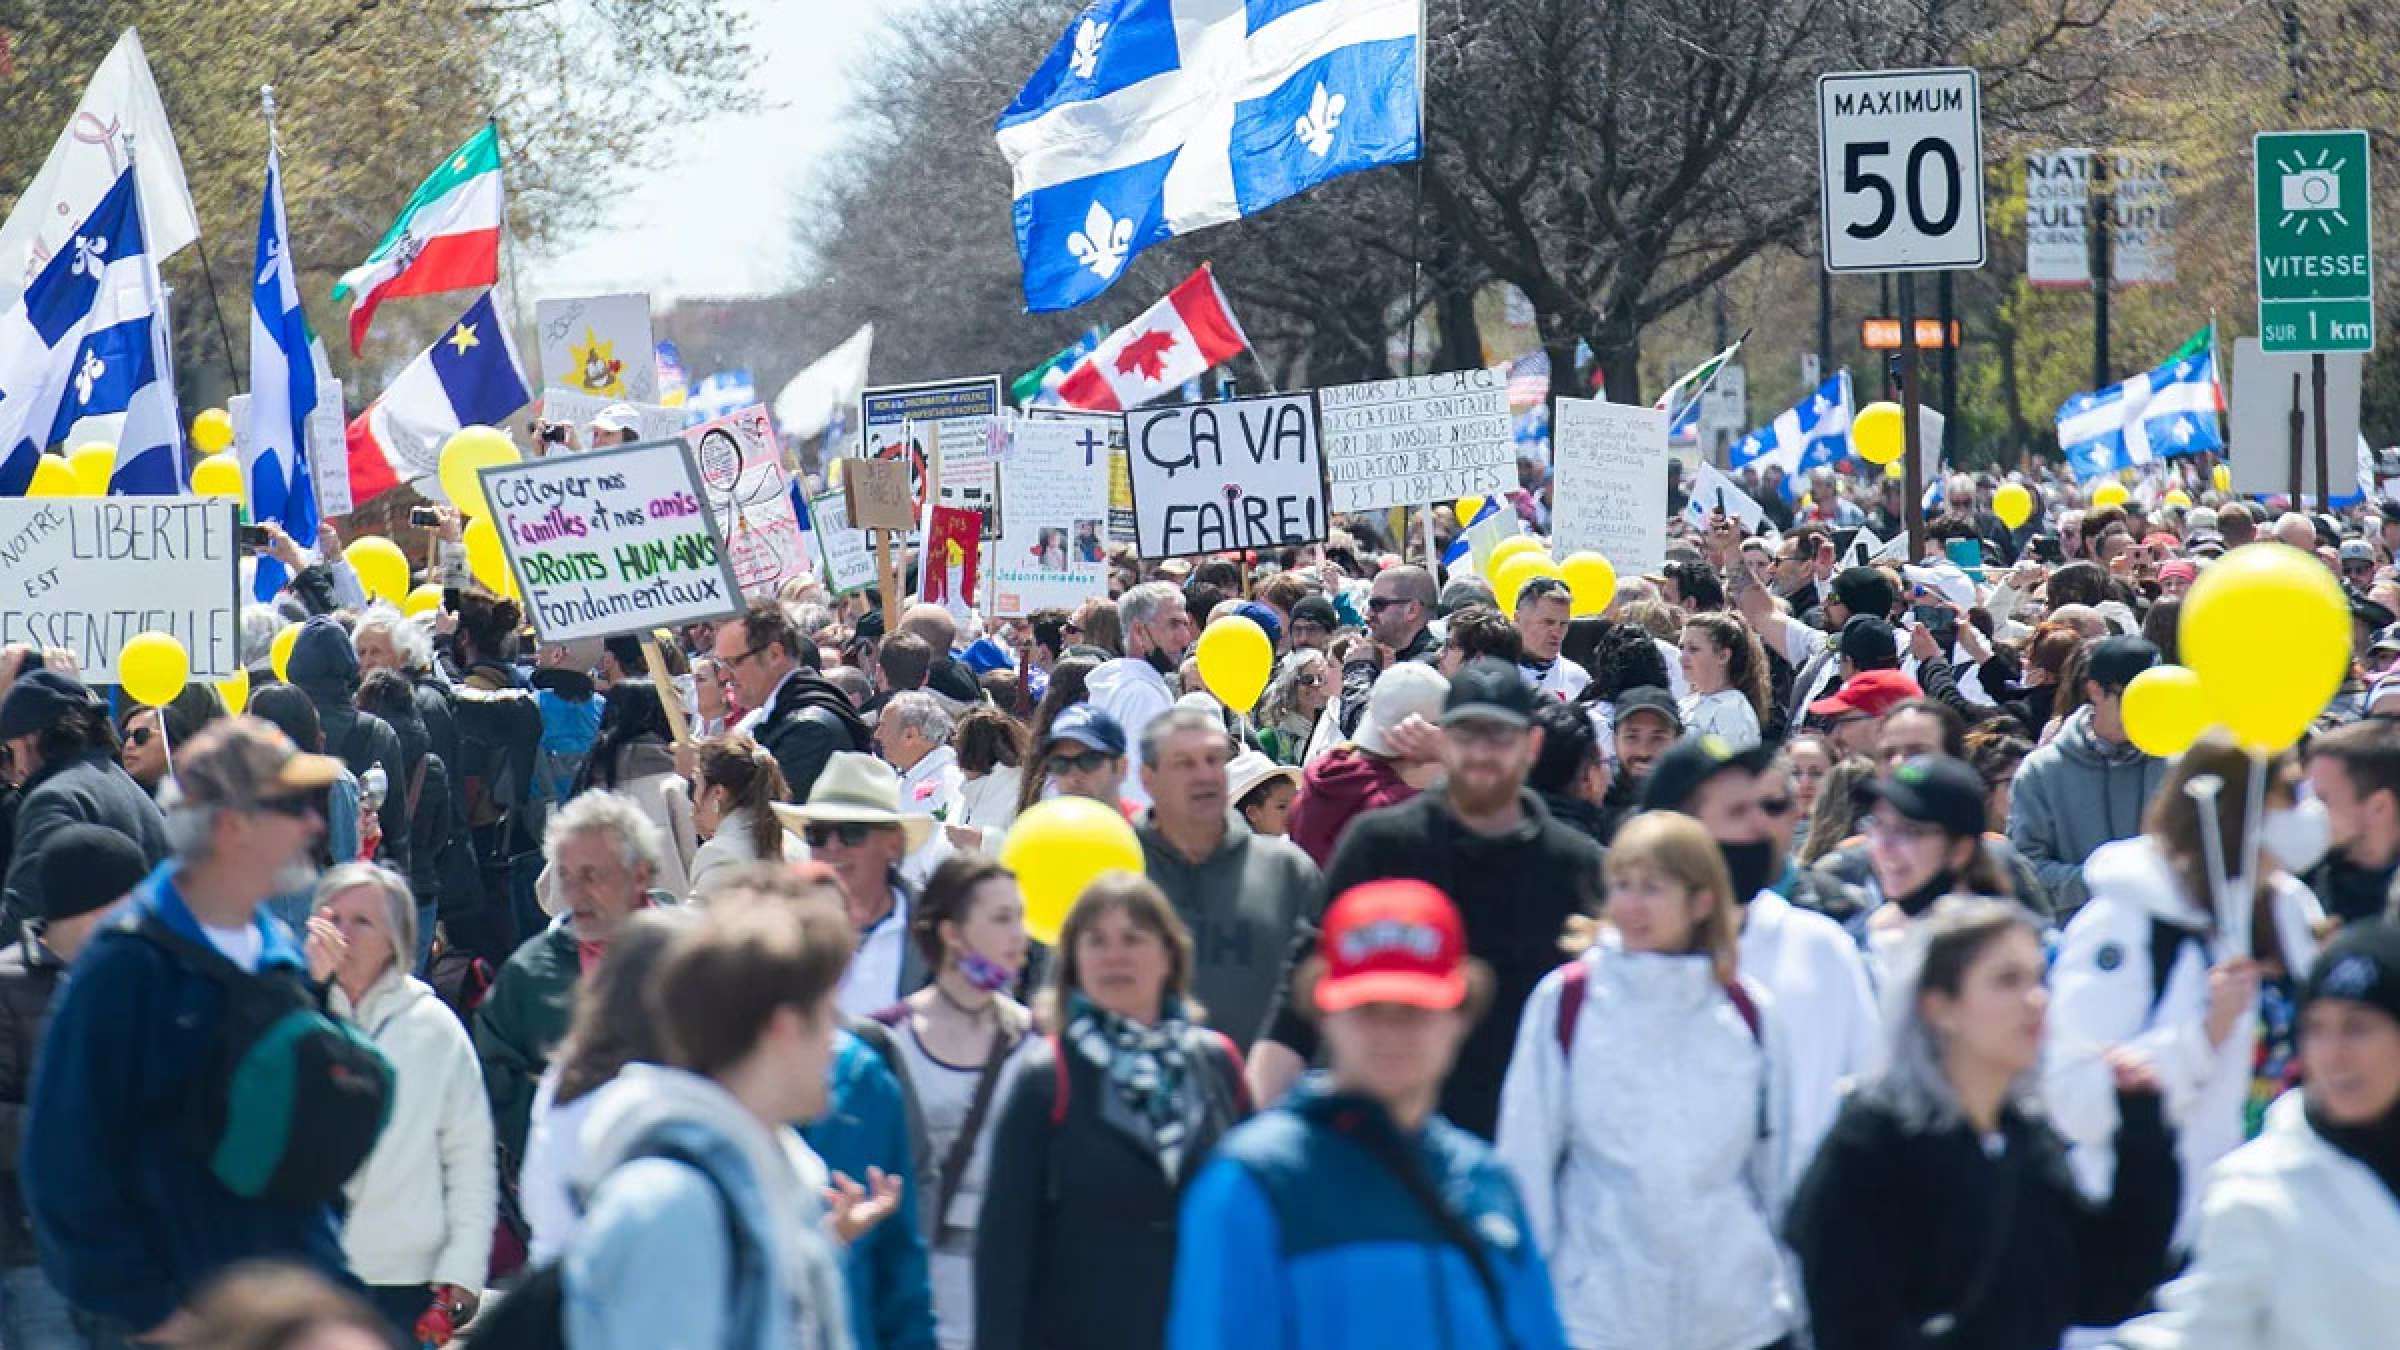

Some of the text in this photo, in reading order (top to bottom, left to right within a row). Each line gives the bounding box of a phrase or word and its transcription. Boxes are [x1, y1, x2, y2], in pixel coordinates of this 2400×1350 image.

[1834, 88, 1963, 117] MAXIMUM
[1844, 137, 1961, 239] 50
[2264, 255, 2366, 277] VITESSE
[2265, 310, 2368, 341] SUR 1 km
[1323, 383, 1386, 407] DEHORS
[1395, 380, 1417, 398] LA
[1424, 393, 1498, 418] SANITAIRE
[1141, 407, 1222, 478] ÇA
[1239, 403, 1307, 464] VA
[1365, 432, 1382, 451] DU
[1391, 424, 1443, 449] MASQUE
[1329, 442, 1506, 482] VIOLATION DES DROITS
[496, 473, 592, 509] Côtoyer
[70, 496, 222, 561] LIBERTÉ
[591, 500, 610, 531] et
[613, 507, 645, 528] nos
[649, 491, 699, 519] amis
[1162, 485, 1316, 556] FAIRE!
[1, 502, 65, 569] NOTRE
[24, 567, 61, 598] EST
[531, 575, 720, 630] Fondamentaux
